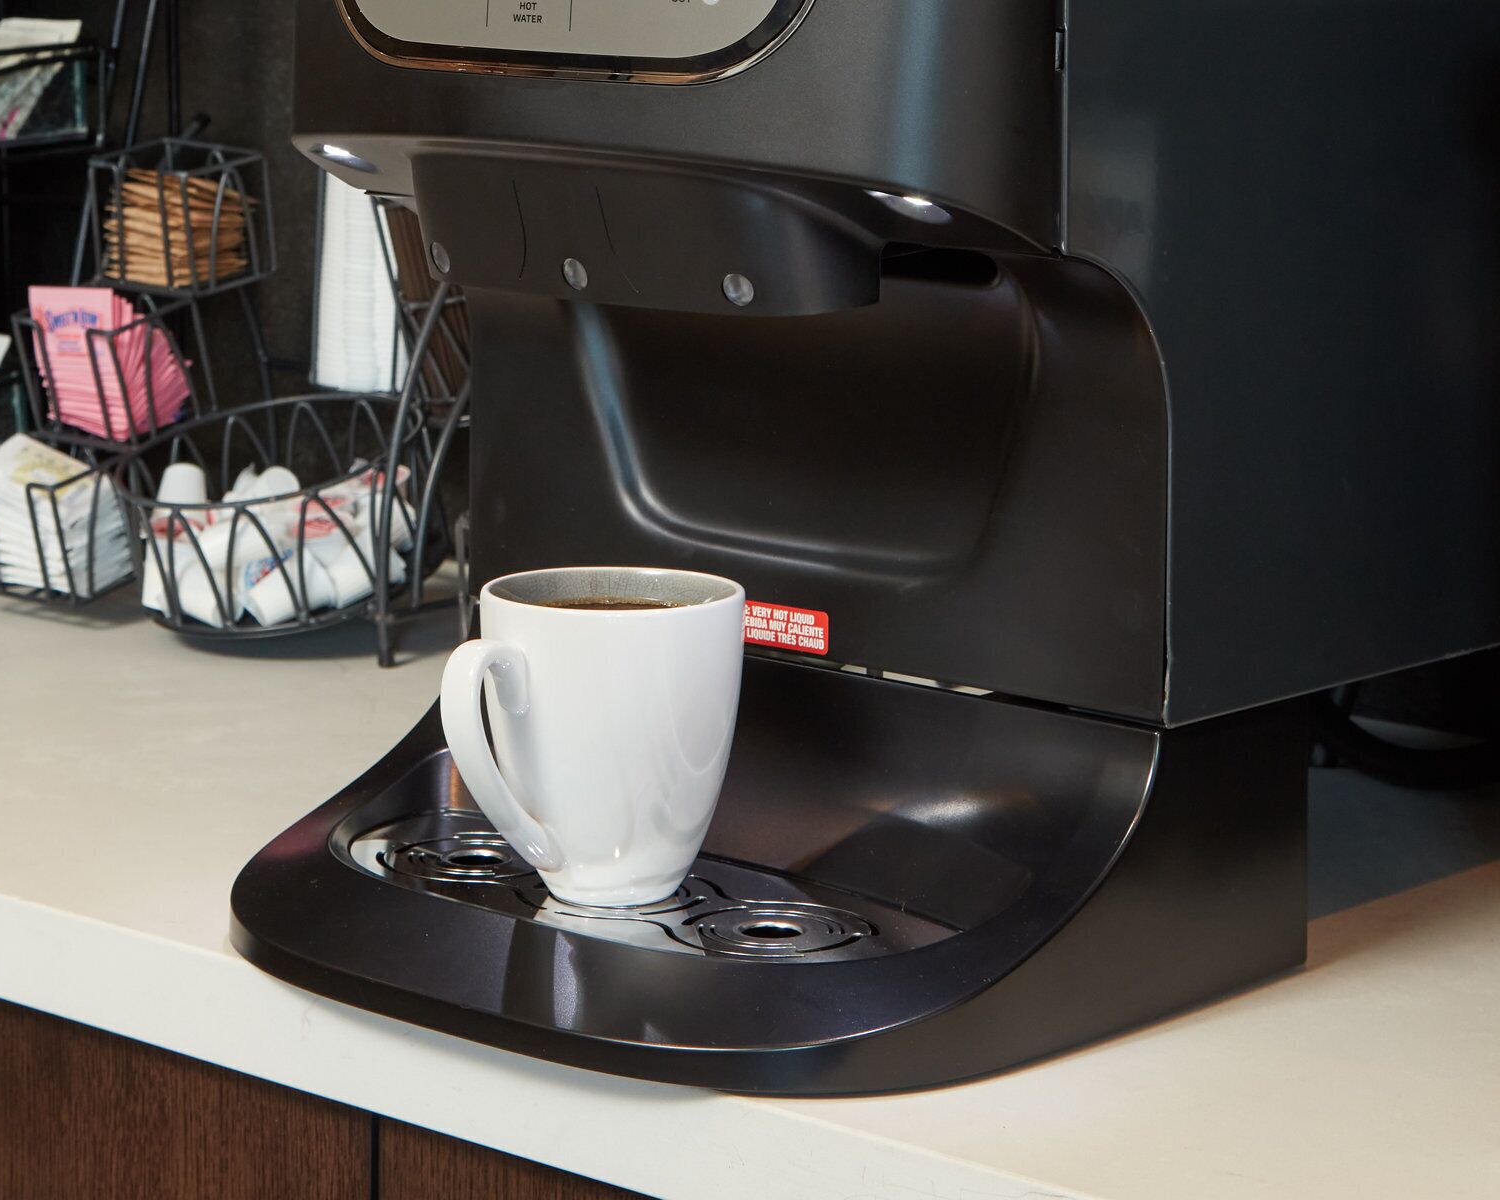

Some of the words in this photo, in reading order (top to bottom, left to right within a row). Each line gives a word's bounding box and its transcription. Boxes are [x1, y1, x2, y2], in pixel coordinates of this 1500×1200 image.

[519, 1, 538, 11] HOT
[512, 13, 543, 24] WATER
[751, 605, 772, 618] VERY
[773, 608, 788, 621] HOT
[789, 611, 815, 626] LIQUID
[746, 627, 776, 642] LIQUIDE
[798, 635, 825, 650] CHAUD
[768, 619, 787, 633] MUY
[787, 622, 824, 639] CALIENTE
